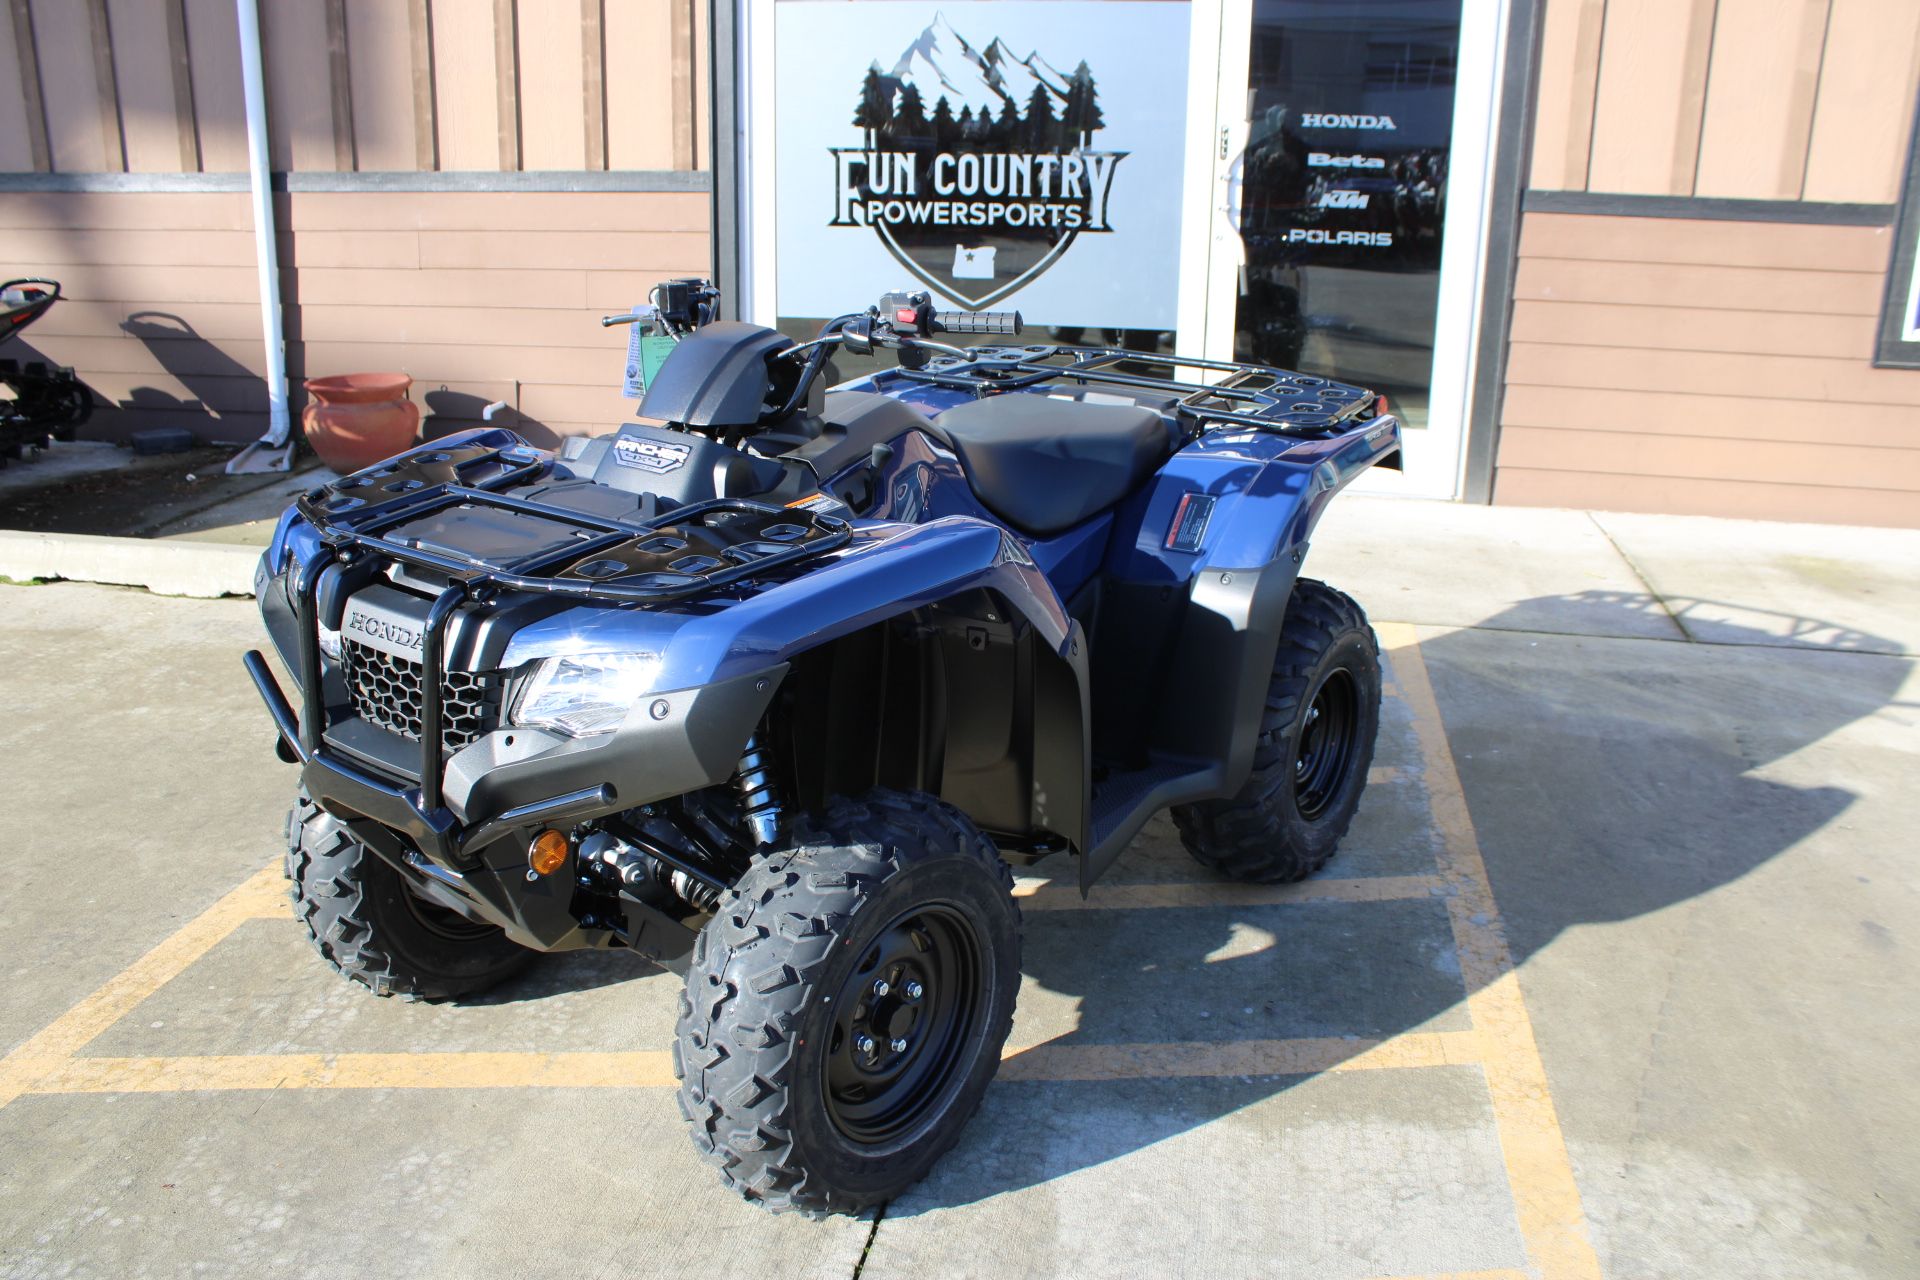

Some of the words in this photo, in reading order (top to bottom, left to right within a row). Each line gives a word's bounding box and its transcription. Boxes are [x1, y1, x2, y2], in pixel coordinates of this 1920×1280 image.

[1301, 114, 1396, 130] HONDA
[1307, 152, 1386, 169] Beta
[836, 151, 916, 223] FUN
[934, 152, 1117, 229] COUNTRY
[1318, 190, 1370, 209] KTM
[867, 201, 1083, 227] POWERSPORTS
[1289, 229, 1393, 246] POLARIS
[614, 439, 689, 463] RANCHER
